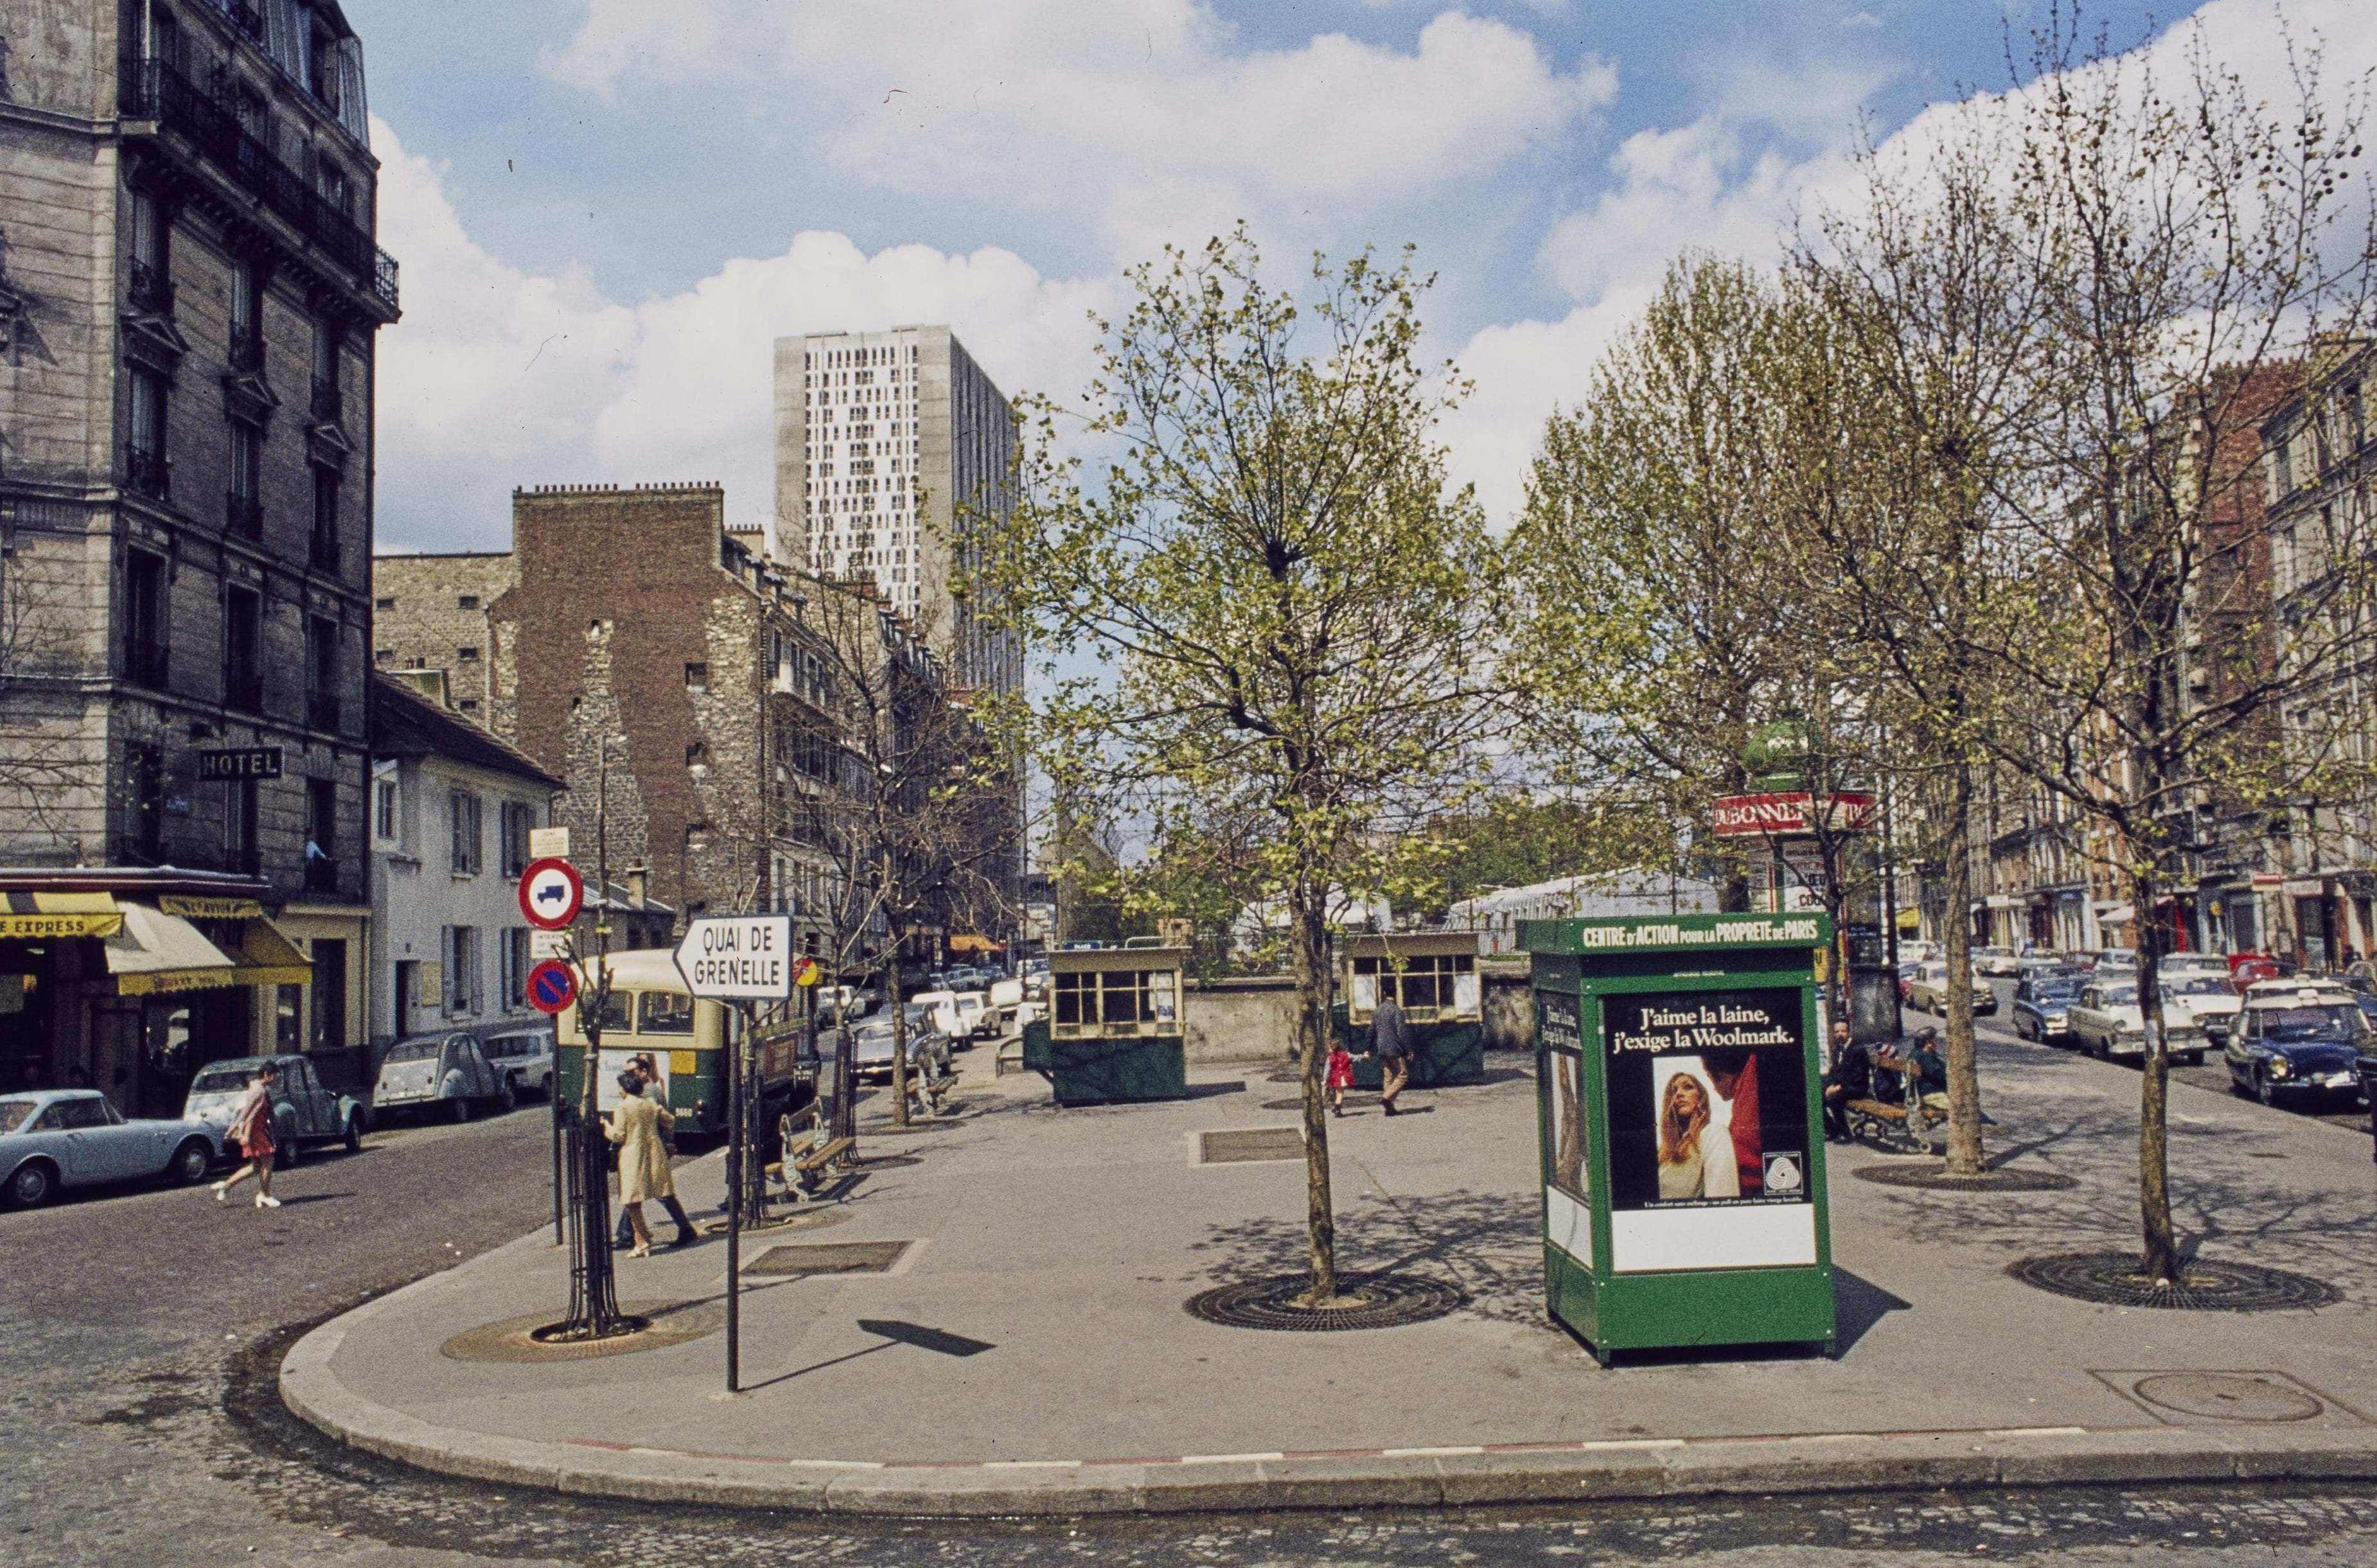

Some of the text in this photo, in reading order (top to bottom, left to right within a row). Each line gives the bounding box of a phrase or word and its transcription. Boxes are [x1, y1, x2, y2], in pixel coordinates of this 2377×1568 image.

[204, 753, 278, 775] HOTEL
[15, 921, 85, 933] EXPRESS
[1583, 927, 1626, 947] CENTRE
[1679, 930, 1704, 944] POUR
[1705, 929, 1715, 942] LA
[1772, 928, 1785, 940] DE
[1785, 919, 1818, 940] PARIS
[703, 926, 772, 956] QUAI DE
[694, 960, 780, 986] GRENELLE
[1640, 1005, 1770, 1030] J'aime la laine,
[1613, 1025, 1795, 1054] j'exige la Woolmark.
